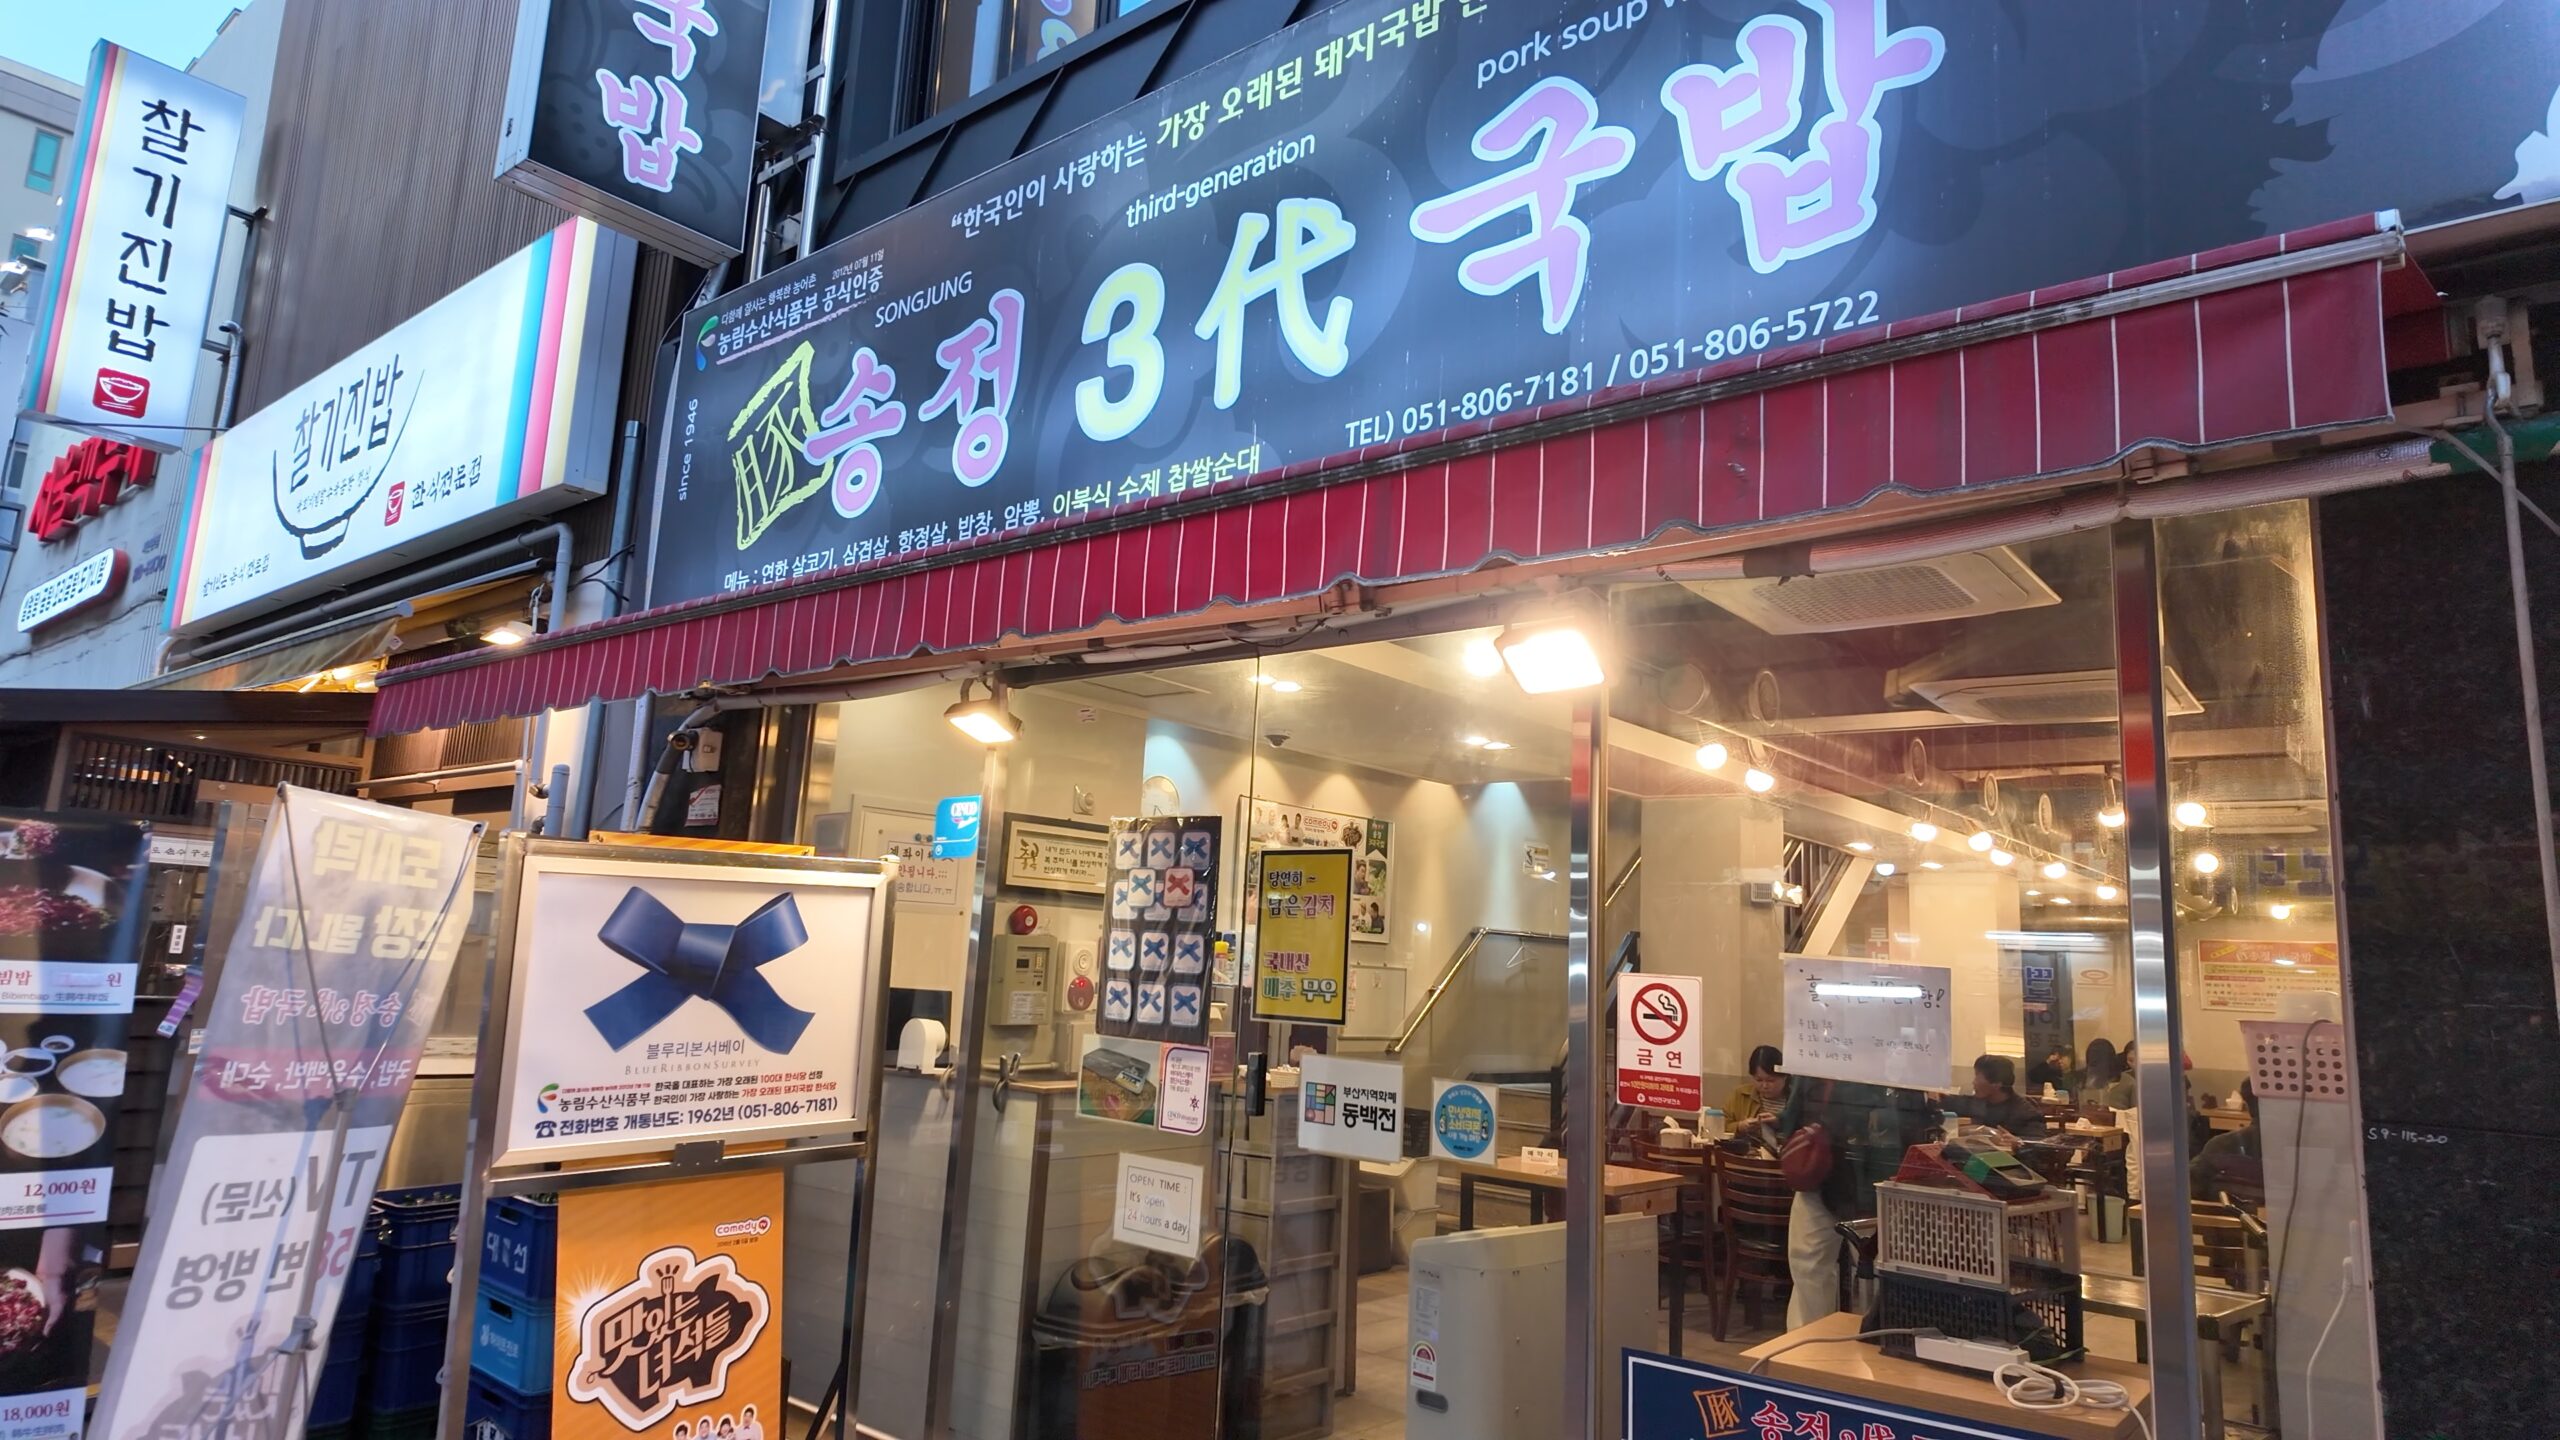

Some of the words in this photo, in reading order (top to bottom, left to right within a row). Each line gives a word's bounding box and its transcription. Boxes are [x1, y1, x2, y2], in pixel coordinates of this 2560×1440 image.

[1477, 31, 1551, 89] pork
[1562, 0, 1648, 49] soup
[1052, 131, 1148, 197] 사랑하는
[1157, 103, 1210, 151] 가장
[1221, 55, 1303, 124] 오래된
[1314, 0, 1444, 80] 돼지국밥
[1126, 131, 1316, 229] third-generation
[105, 98, 206, 363] 찰기진밥
[803, 288, 1025, 519] 송정
[1075, 197, 1356, 442] 3代
[1410, 0, 1945, 334] 국밥
[717, 292, 818, 356] 농림수산식품부
[822, 264, 884, 313] 공식인증
[721, 309, 743, 326] 다함께
[744, 296, 767, 315] 잘사는
[768, 284, 792, 306] 행복한
[875, 271, 973, 329] SONGJUNG
[1345, 410, 1395, 449] TEL)
[1401, 361, 1595, 434] 051-806-7181
[1629, 290, 1880, 382] 051-806-5722
[290, 353, 404, 494] 찰기진밥
[684, 398, 699, 448] 1946
[679, 453, 692, 501] since
[724, 569, 750, 593] 메뉴
[761, 558, 789, 585] 연한
[791, 547, 838, 575] 살코기,
[842, 533, 893, 569] 삼겹살,
[898, 519, 951, 554] 항정살,
[1053, 481, 1111, 518] 이북식
[1117, 469, 1160, 503] 수제
[1167, 443, 1260, 493] 찹쌀순대
[1268, 870, 1303, 889] 당연히
[1302, 893, 1336, 918] 김치
[1264, 952, 1310, 973] 국내산
[1263, 976, 1297, 1001] 배추
[646, 1038, 745, 1060] 블루리본서베이
[653, 1093, 687, 1105] 한국인이
[689, 1091, 706, 1102] 가장
[708, 1089, 740, 1101] 사랑하는
[741, 1087, 758, 1098] 가장
[759, 1085, 782, 1097] 오래된
[815, 1081, 837, 1092] 한식당
[655, 1080, 680, 1092] 한국을
[682, 1077, 714, 1089] 대표하는
[717, 1076, 733, 1087] 가장
[735, 1075, 758, 1086] 오래된
[760, 1073, 783, 1084] 100대
[784, 1071, 807, 1082] 한식당
[1343, 1086, 1397, 1104] 부산지역화폐
[559, 1092, 651, 1112] 농림수산식품부
[560, 1116, 619, 1136] 전화번호
[623, 1112, 684, 1130] 개통년도:
[687, 1105, 734, 1124] 1962년
[738, 1096, 838, 1120] (051-806-7181)
[1342, 1102, 1396, 1133] 동백전
[24, 1178, 96, 1198] 12,000원
[1129, 1174, 1155, 1188] OPEN
[1159, 1179, 1181, 1193] TIME
[1129, 1191, 1141, 1203] It's
[1144, 1195, 1165, 1208] open
[717, 1221, 757, 1235] comedy
[1127, 1210, 1137, 1221] 24
[1140, 1212, 1162, 1227] hours
[1164, 1218, 1170, 1229] a
[592, 1293, 700, 1374] 맛있는
[638, 1300, 732, 1400] 녀석들
[3, 1399, 70, 1422] 18,000원
